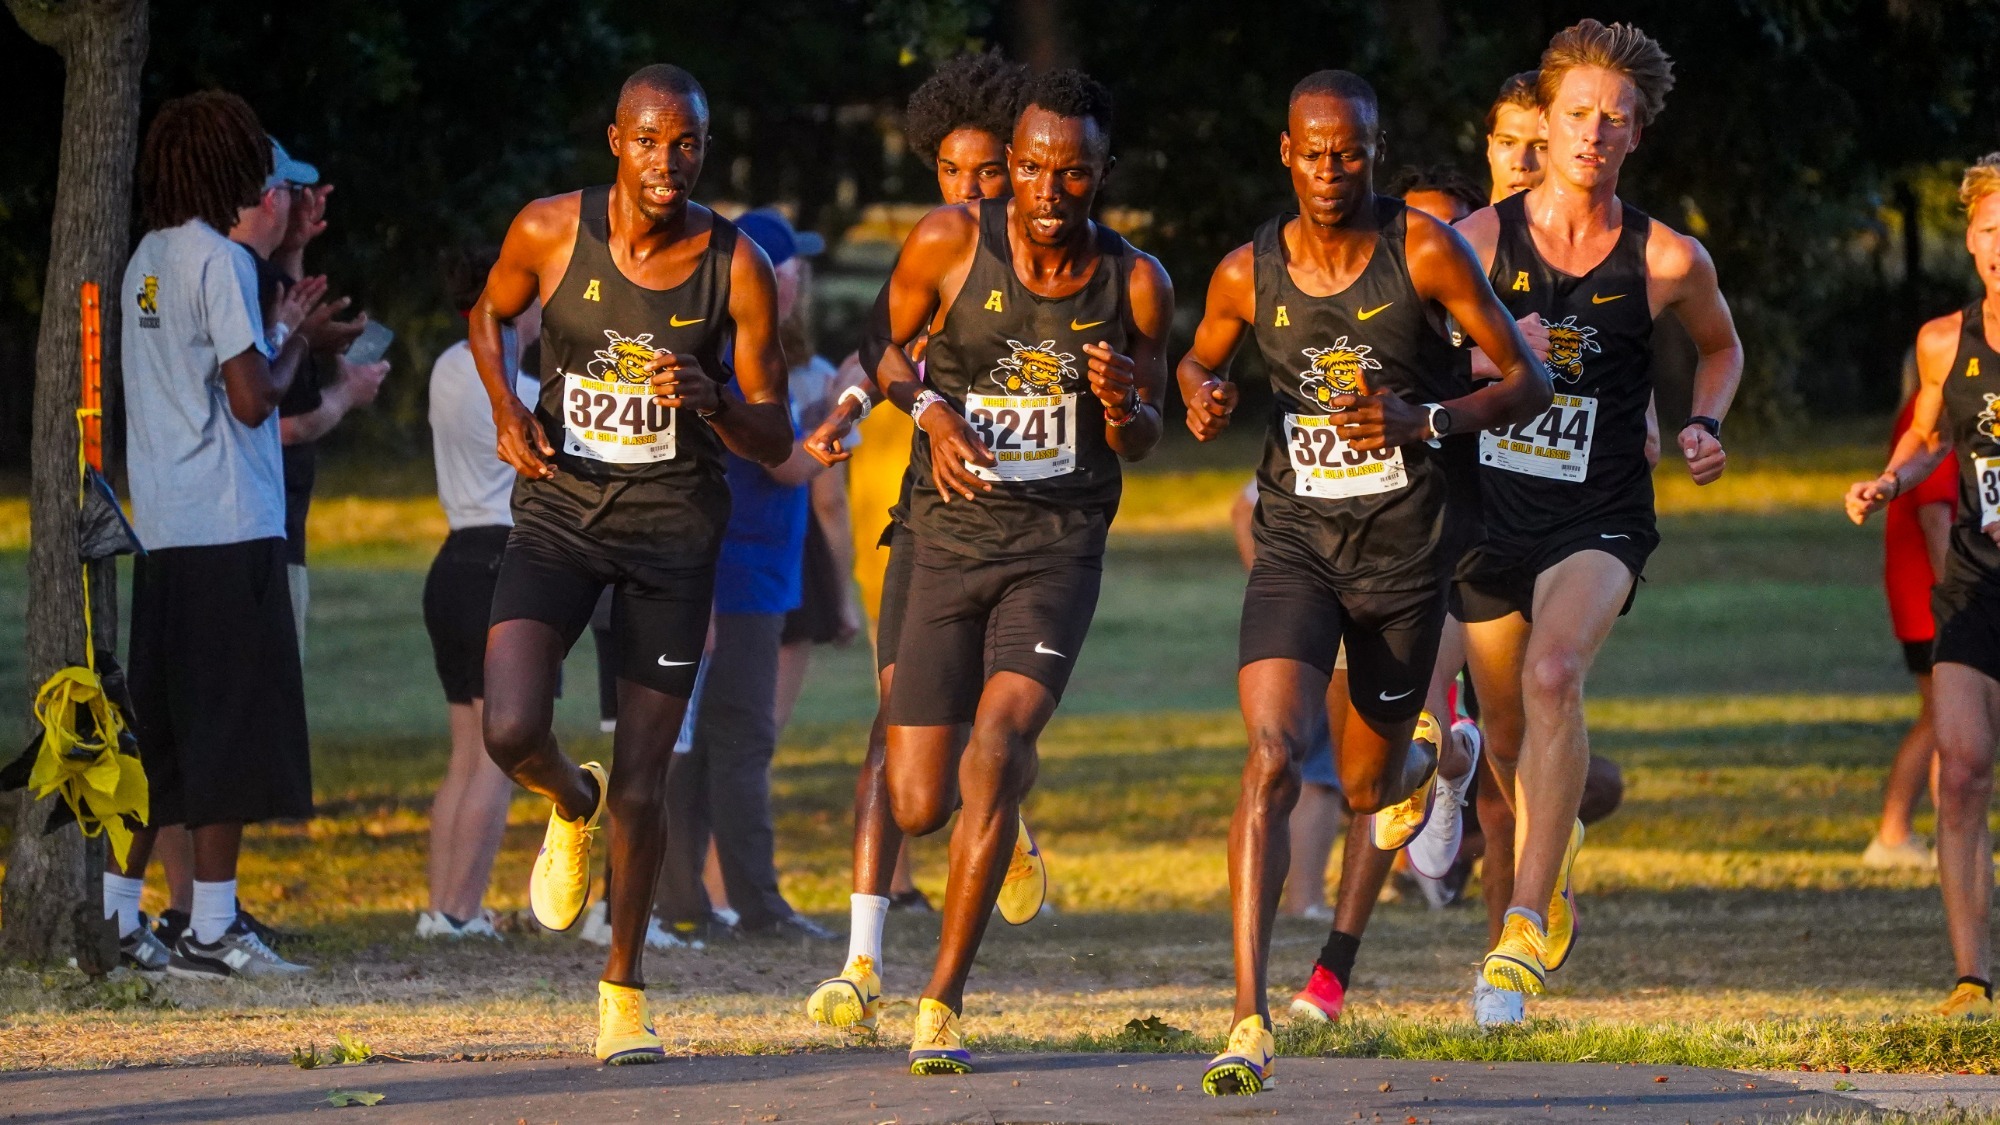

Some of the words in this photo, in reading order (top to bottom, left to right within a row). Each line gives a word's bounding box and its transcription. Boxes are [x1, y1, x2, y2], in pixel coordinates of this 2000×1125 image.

[583, 279, 600, 302] A
[1512, 271, 1530, 292] A
[984, 289, 1002, 313] A
[1274, 305, 1290, 327] A
[1966, 358, 1980, 377] A
[580, 378, 615, 394] WICHITA
[617, 386, 645, 396] STATE
[982, 397, 1018, 408] WICHITA
[1021, 397, 1048, 408] STATE
[1552, 394, 1568, 406] ATE
[569, 388, 671, 435] 3240
[970, 405, 1066, 450] 3241
[597, 432, 618, 443] GOLD
[621, 434, 657, 446] CLASSIC
[1497, 439, 1510, 449] JK
[1510, 441, 1533, 455] GOLD
[1534, 446, 1571, 460] CLASSIC
[999, 451, 1022, 462] GOLD
[1024, 448, 1060, 461] CLASSIC
[1323, 469, 1345, 480] GOLD
[1346, 462, 1385, 478] CLASSIC
[222, 948, 251, 969] N
